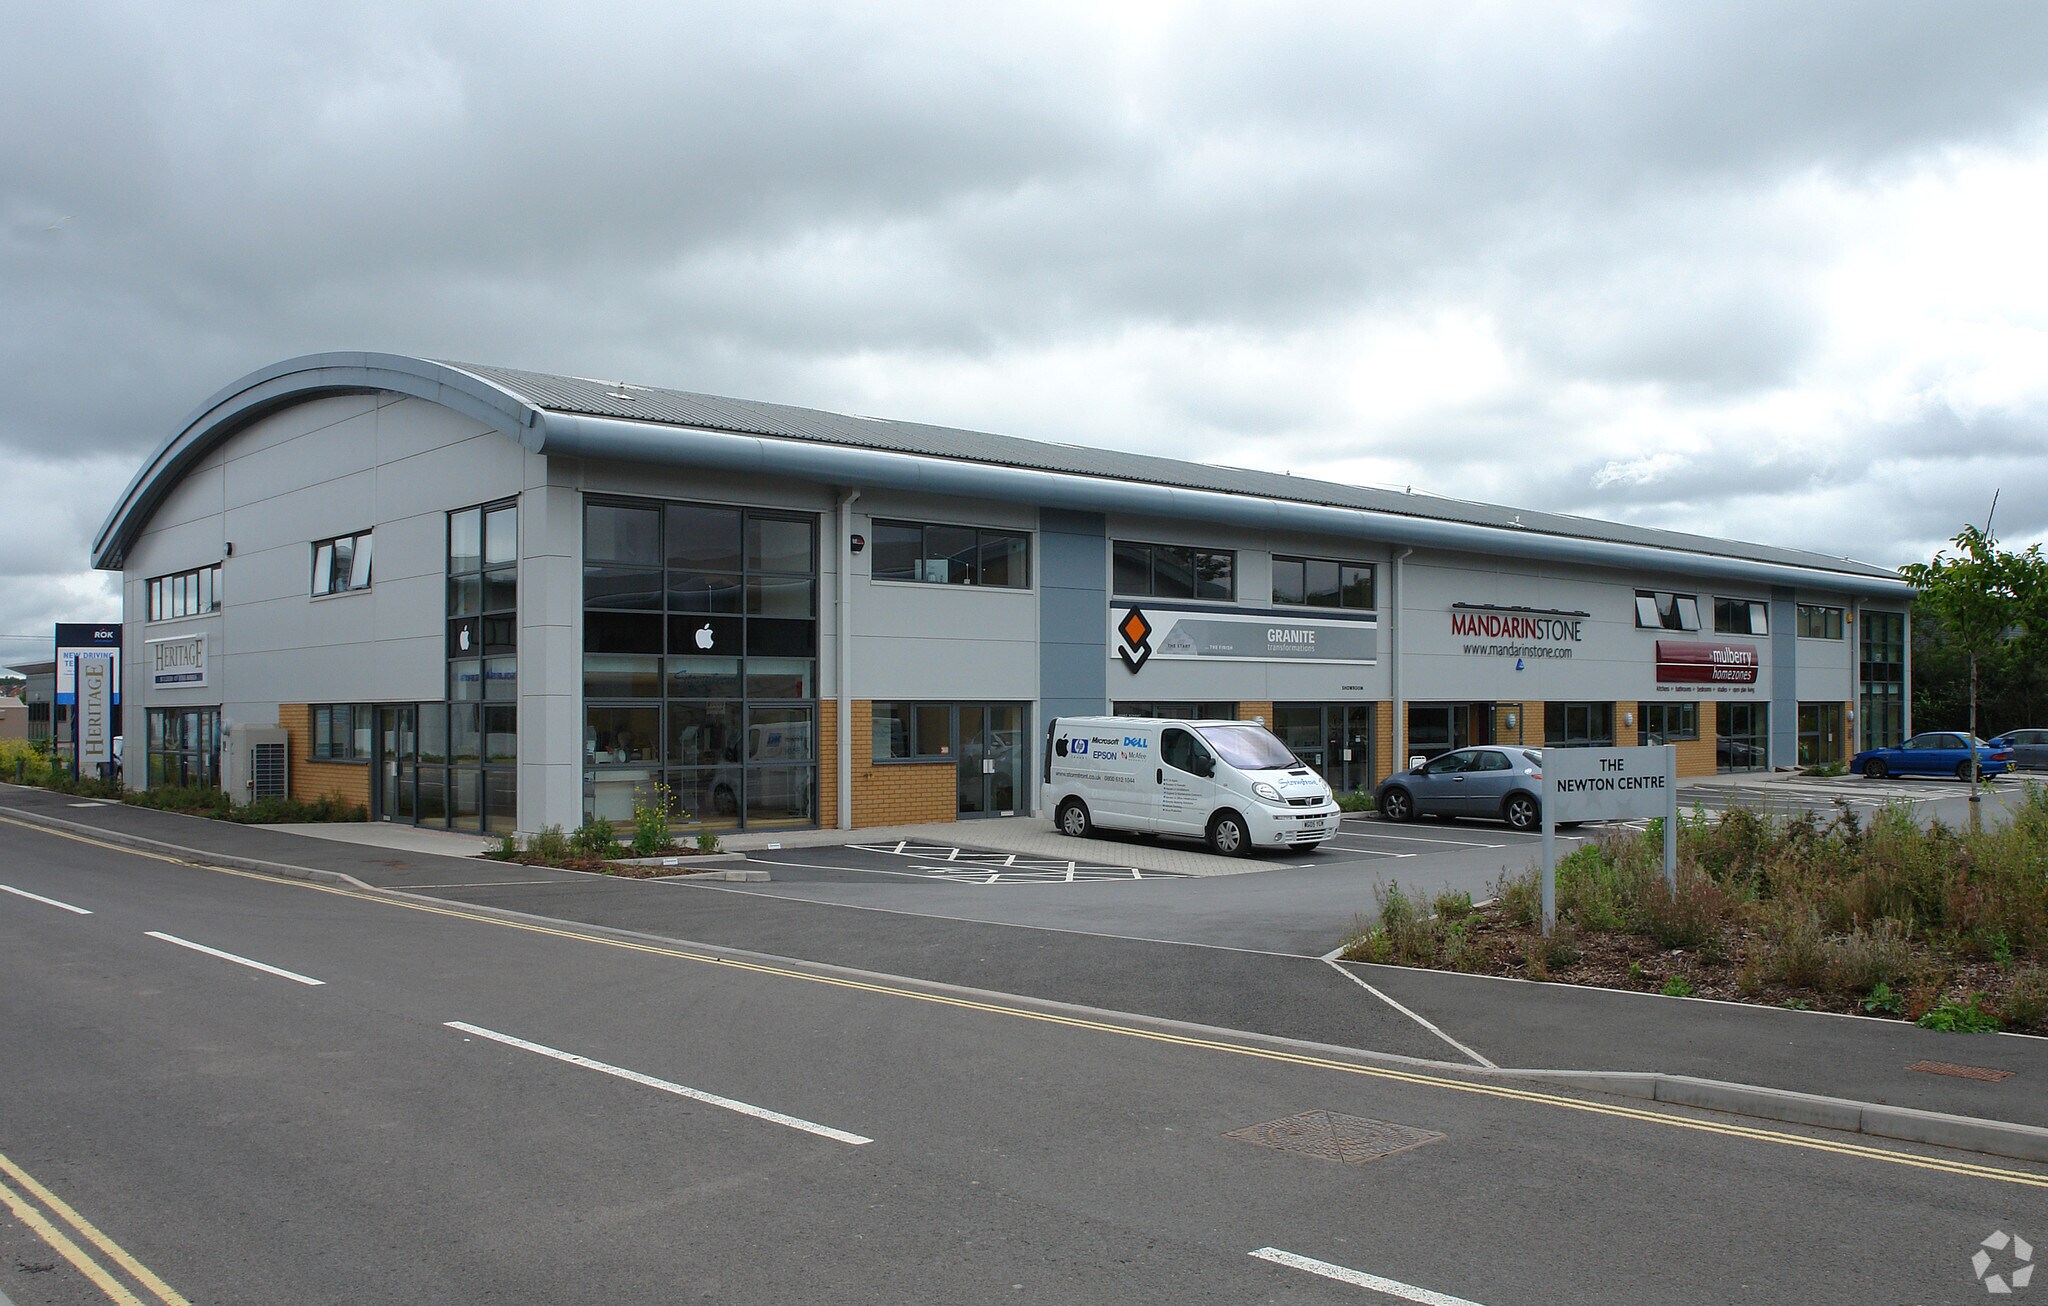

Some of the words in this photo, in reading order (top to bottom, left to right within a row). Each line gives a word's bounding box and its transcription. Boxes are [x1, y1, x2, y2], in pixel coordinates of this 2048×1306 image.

[1451, 613, 1582, 641] MANDARINSTONE
[1267, 628, 1315, 643] GRANITE
[1267, 643, 1315, 652] transformations
[1463, 642, 1573, 658] www.mandarinstone.com
[155, 639, 202, 671] HERITAGE
[1713, 647, 1752, 666] mulberry
[1712, 666, 1752, 680] homezones
[85, 665, 104, 756] HERITAGE
[1092, 737, 1119, 746] Microsoft
[1123, 737, 1148, 748] DELL
[1093, 751, 1117, 760] EPSON
[1129, 751, 1146, 760] McAfee
[1599, 759, 1624, 771] THE
[1557, 778, 1614, 792] NEWTON
[1617, 776, 1665, 790] CENTRE
